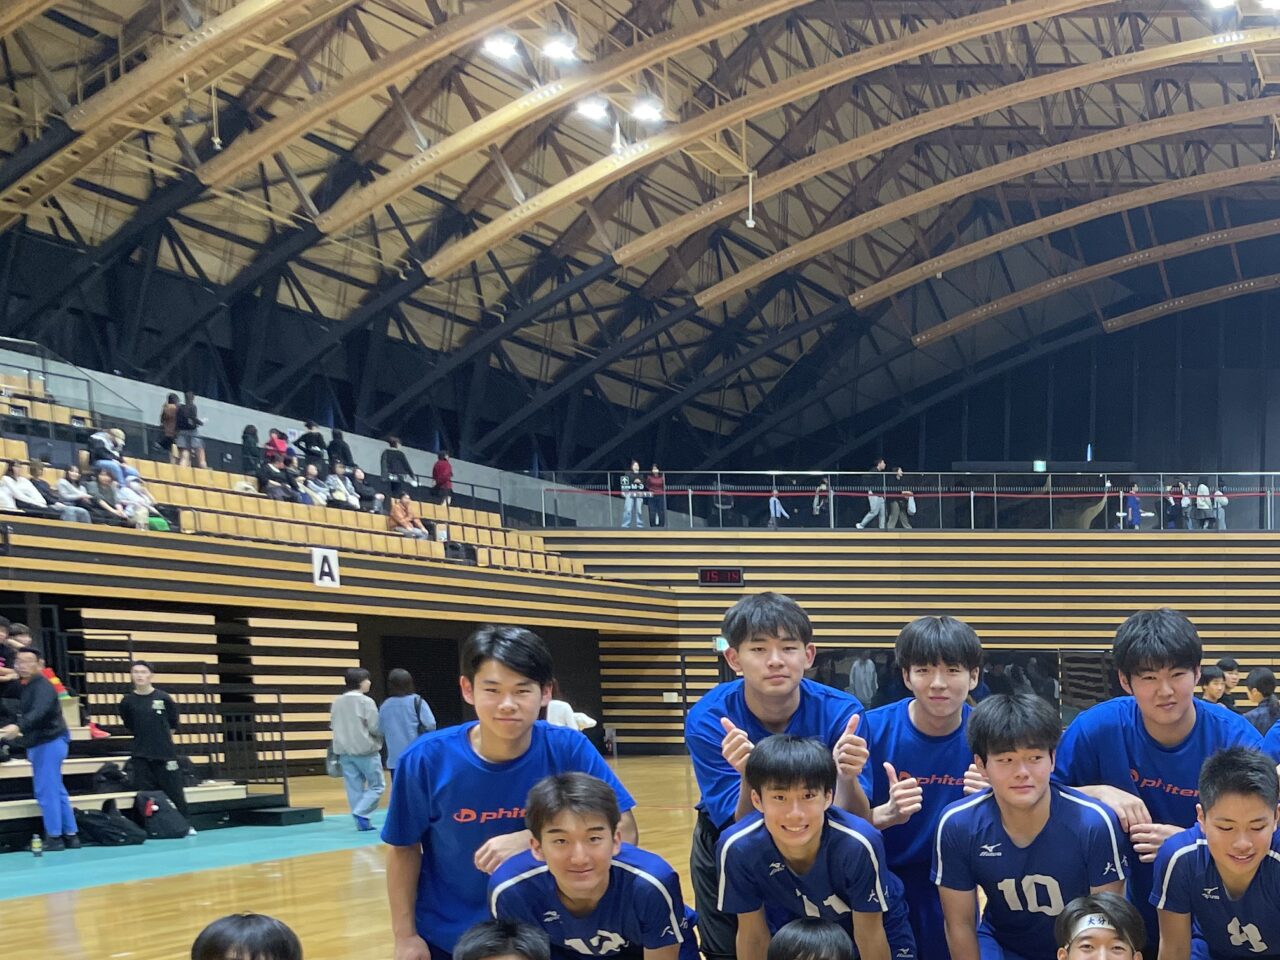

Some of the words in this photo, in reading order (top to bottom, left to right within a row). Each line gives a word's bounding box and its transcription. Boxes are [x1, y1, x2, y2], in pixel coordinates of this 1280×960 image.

[319, 555, 336, 582] A
[915, 774, 964, 786] phite
[480, 807, 528, 824] phit
[997, 874, 1066, 917] 10
